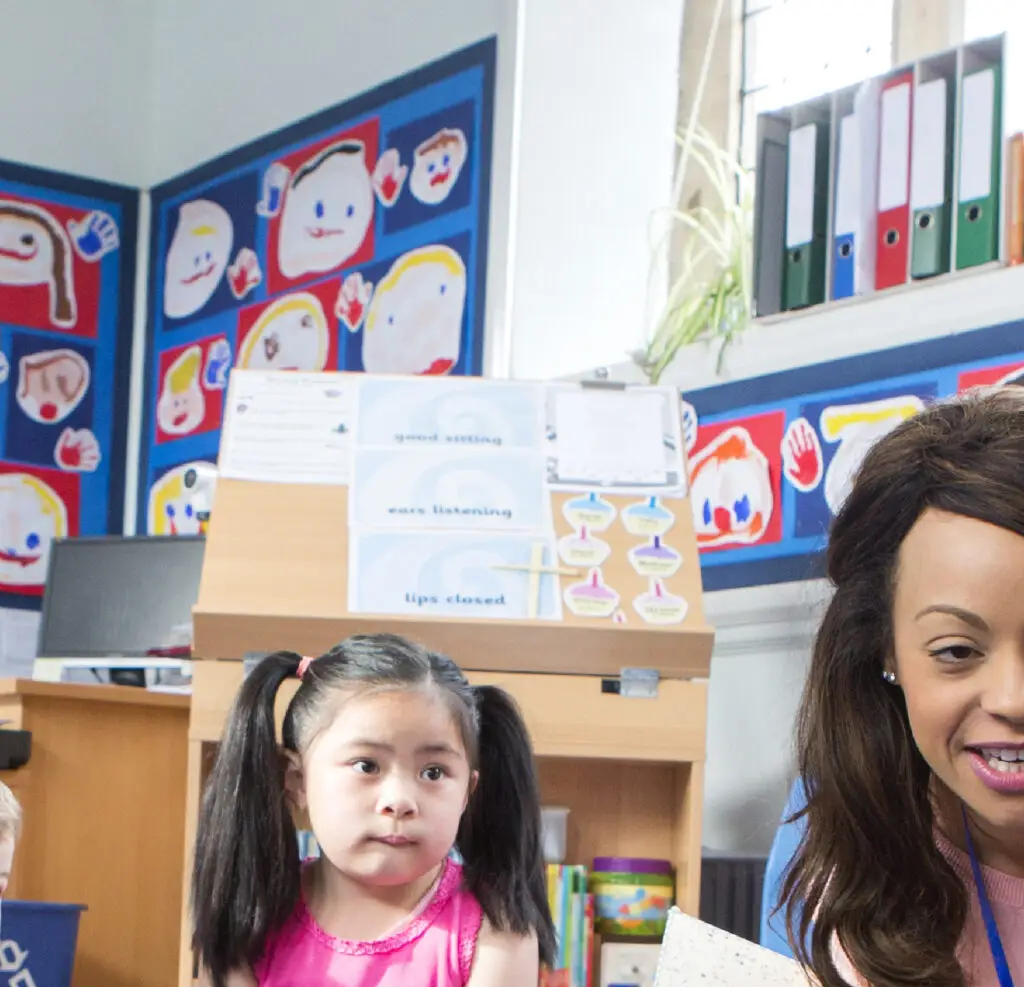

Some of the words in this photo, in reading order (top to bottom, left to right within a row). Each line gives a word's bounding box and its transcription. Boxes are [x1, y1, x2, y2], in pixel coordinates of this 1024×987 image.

[394, 431, 438, 444] good
[445, 432, 502, 446] sitting
[388, 506, 426, 515] ears
[433, 504, 512, 519] listening
[405, 592, 438, 607] lips
[446, 593, 506, 606] closed
